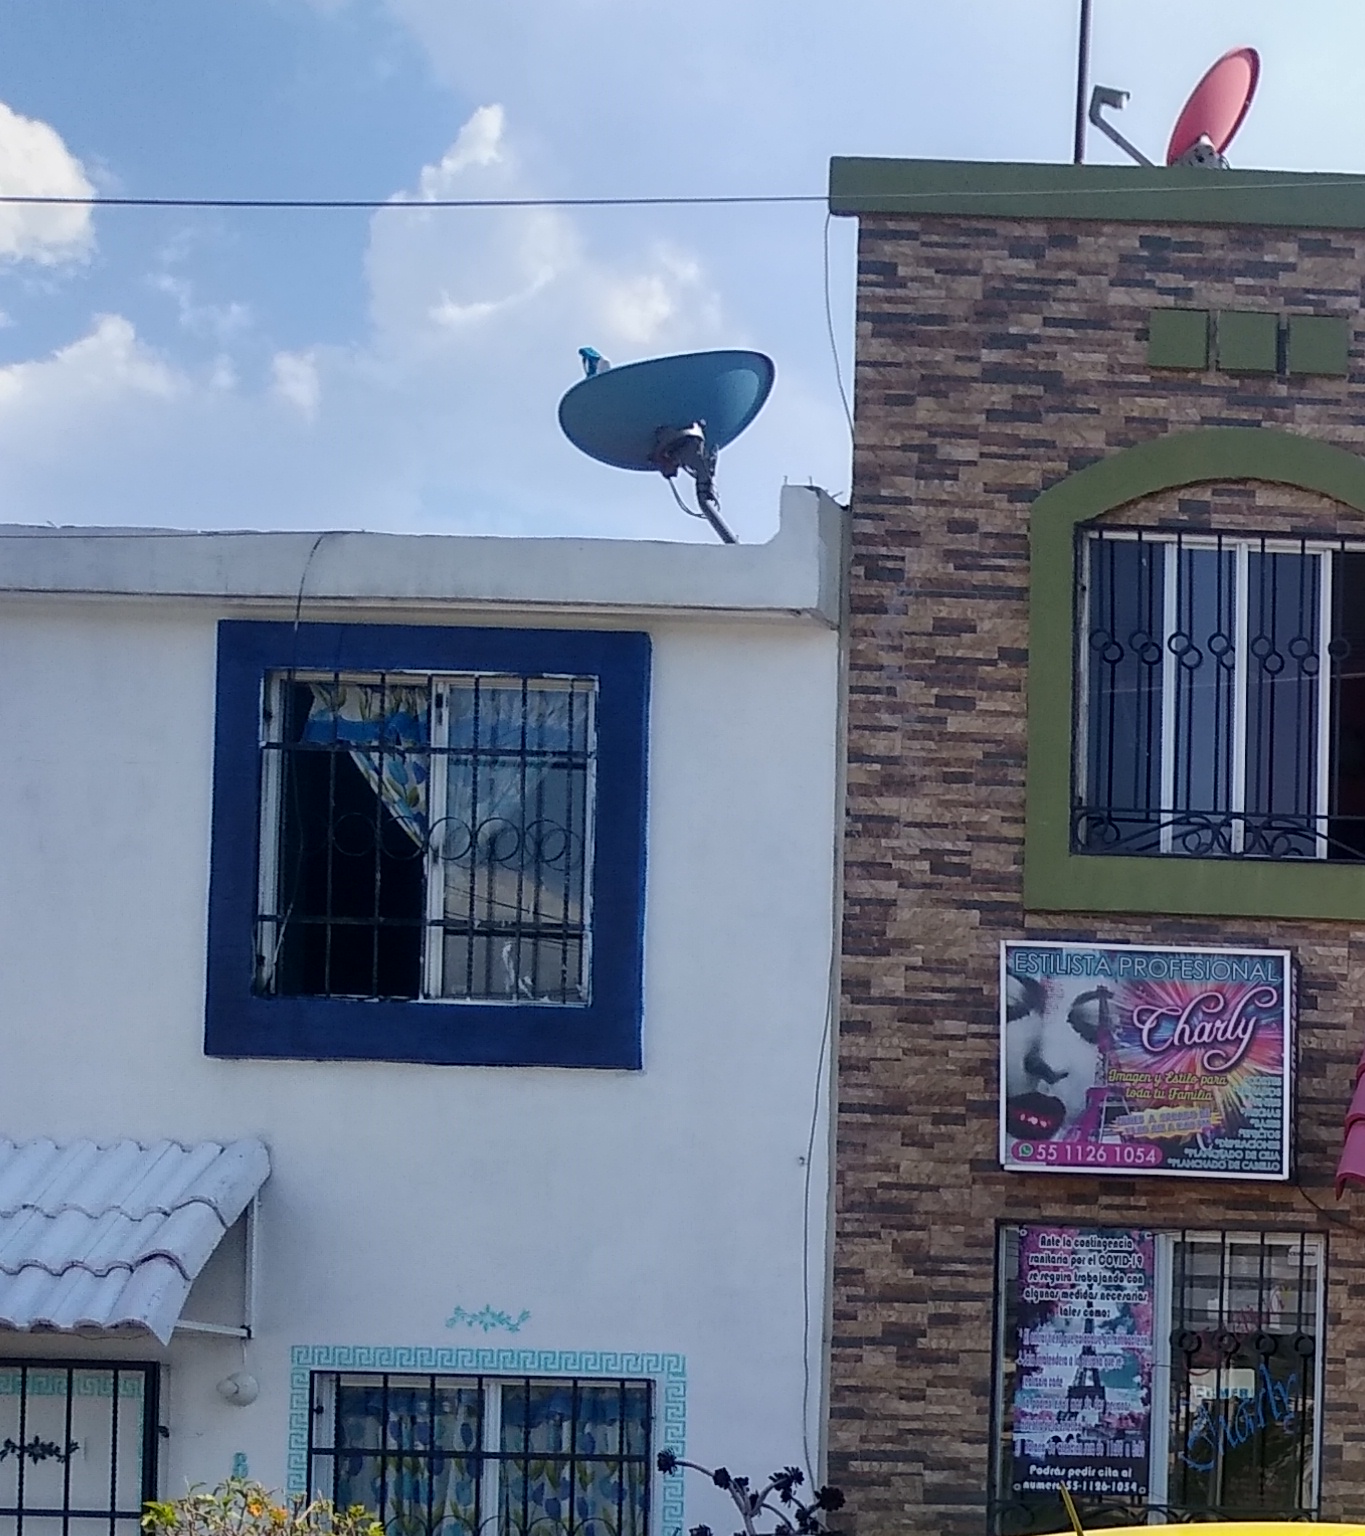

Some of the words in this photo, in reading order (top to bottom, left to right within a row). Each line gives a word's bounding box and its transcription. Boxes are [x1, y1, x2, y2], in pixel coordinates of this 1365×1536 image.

[1014, 952, 1111, 976] ESTILISTA
[1119, 957, 1280, 982] PROFESIONAL
[1133, 986, 1278, 1072] Charly
[1108, 1069, 1152, 1084] Imagen
[1154, 1073, 1163, 1085] y
[1165, 1071, 1199, 1085] Estilo
[1200, 1075, 1229, 1089] para
[1125, 1087, 1152, 1099] toda
[1153, 1088, 1166, 1099] tu
[1168, 1087, 1214, 1101] Familia
[1036, 1144, 1057, 1161] 55
[1065, 1145, 1107, 1162] 1126
[1113, 1147, 1157, 1163] 1054
[1040, 1235, 1061, 1247] Ante
[1074, 1236, 1133, 1251] contingencia
[1030, 1252, 1069, 1265] sanitaria
[1070, 1255, 1086, 1268] por
[1088, 1254, 1097, 1265] el
[1099, 1254, 1144, 1267] COVID-19
[1074, 1271, 1125, 1286] trabajando
[1127, 1274, 1144, 1284] con
[1025, 1288, 1059, 1303] algunas
[1061, 1289, 1098, 1301] medidas
[1100, 1290, 1148, 1302] necesarias
[1060, 1305, 1081, 1317] tales
[1067, 1466, 1096, 1479] pedir
[1097, 1467, 1120, 1478] cita
[1121, 1467, 1133, 1478] al
